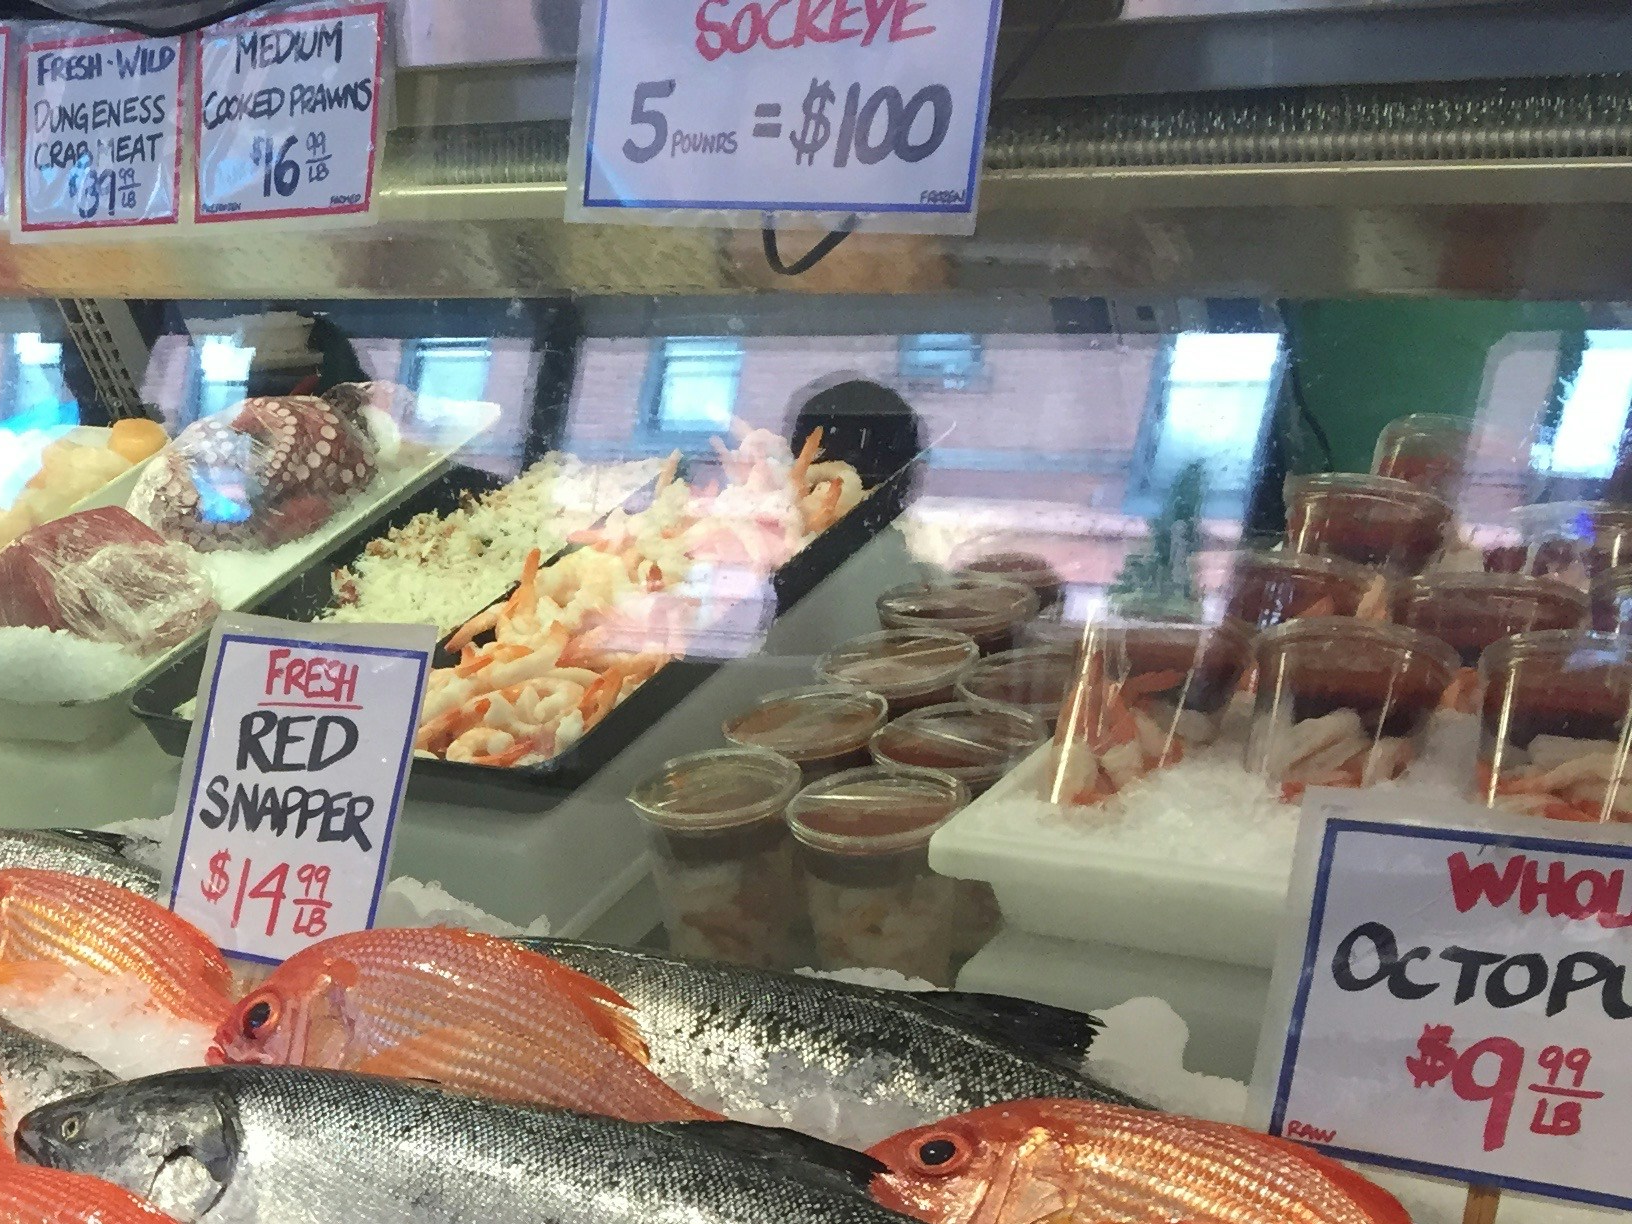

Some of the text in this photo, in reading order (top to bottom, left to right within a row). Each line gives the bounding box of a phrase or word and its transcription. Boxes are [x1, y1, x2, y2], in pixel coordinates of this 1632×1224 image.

[235, 20, 344, 74] MEDIUM
[694, 0, 936, 62] SOCKEYE
[34, 94, 166, 134] DUNGENESS
[203, 77, 373, 130] COOKED PRAWNS
[621, 78, 678, 164] 5
[671, 130, 738, 159] POUNDS
[789, 77, 954, 168] $100
[34, 132, 164, 168] CRAB MEAT
[264, 648, 360, 703] FRESH
[235, 709, 360, 775] RED
[198, 773, 375, 853] SNAPPER
[200, 848, 332, 938] $14 99 LB
[1405, 1023, 1593, 1152] $9 99 LB
[1285, 1119, 1338, 1144] RAW
